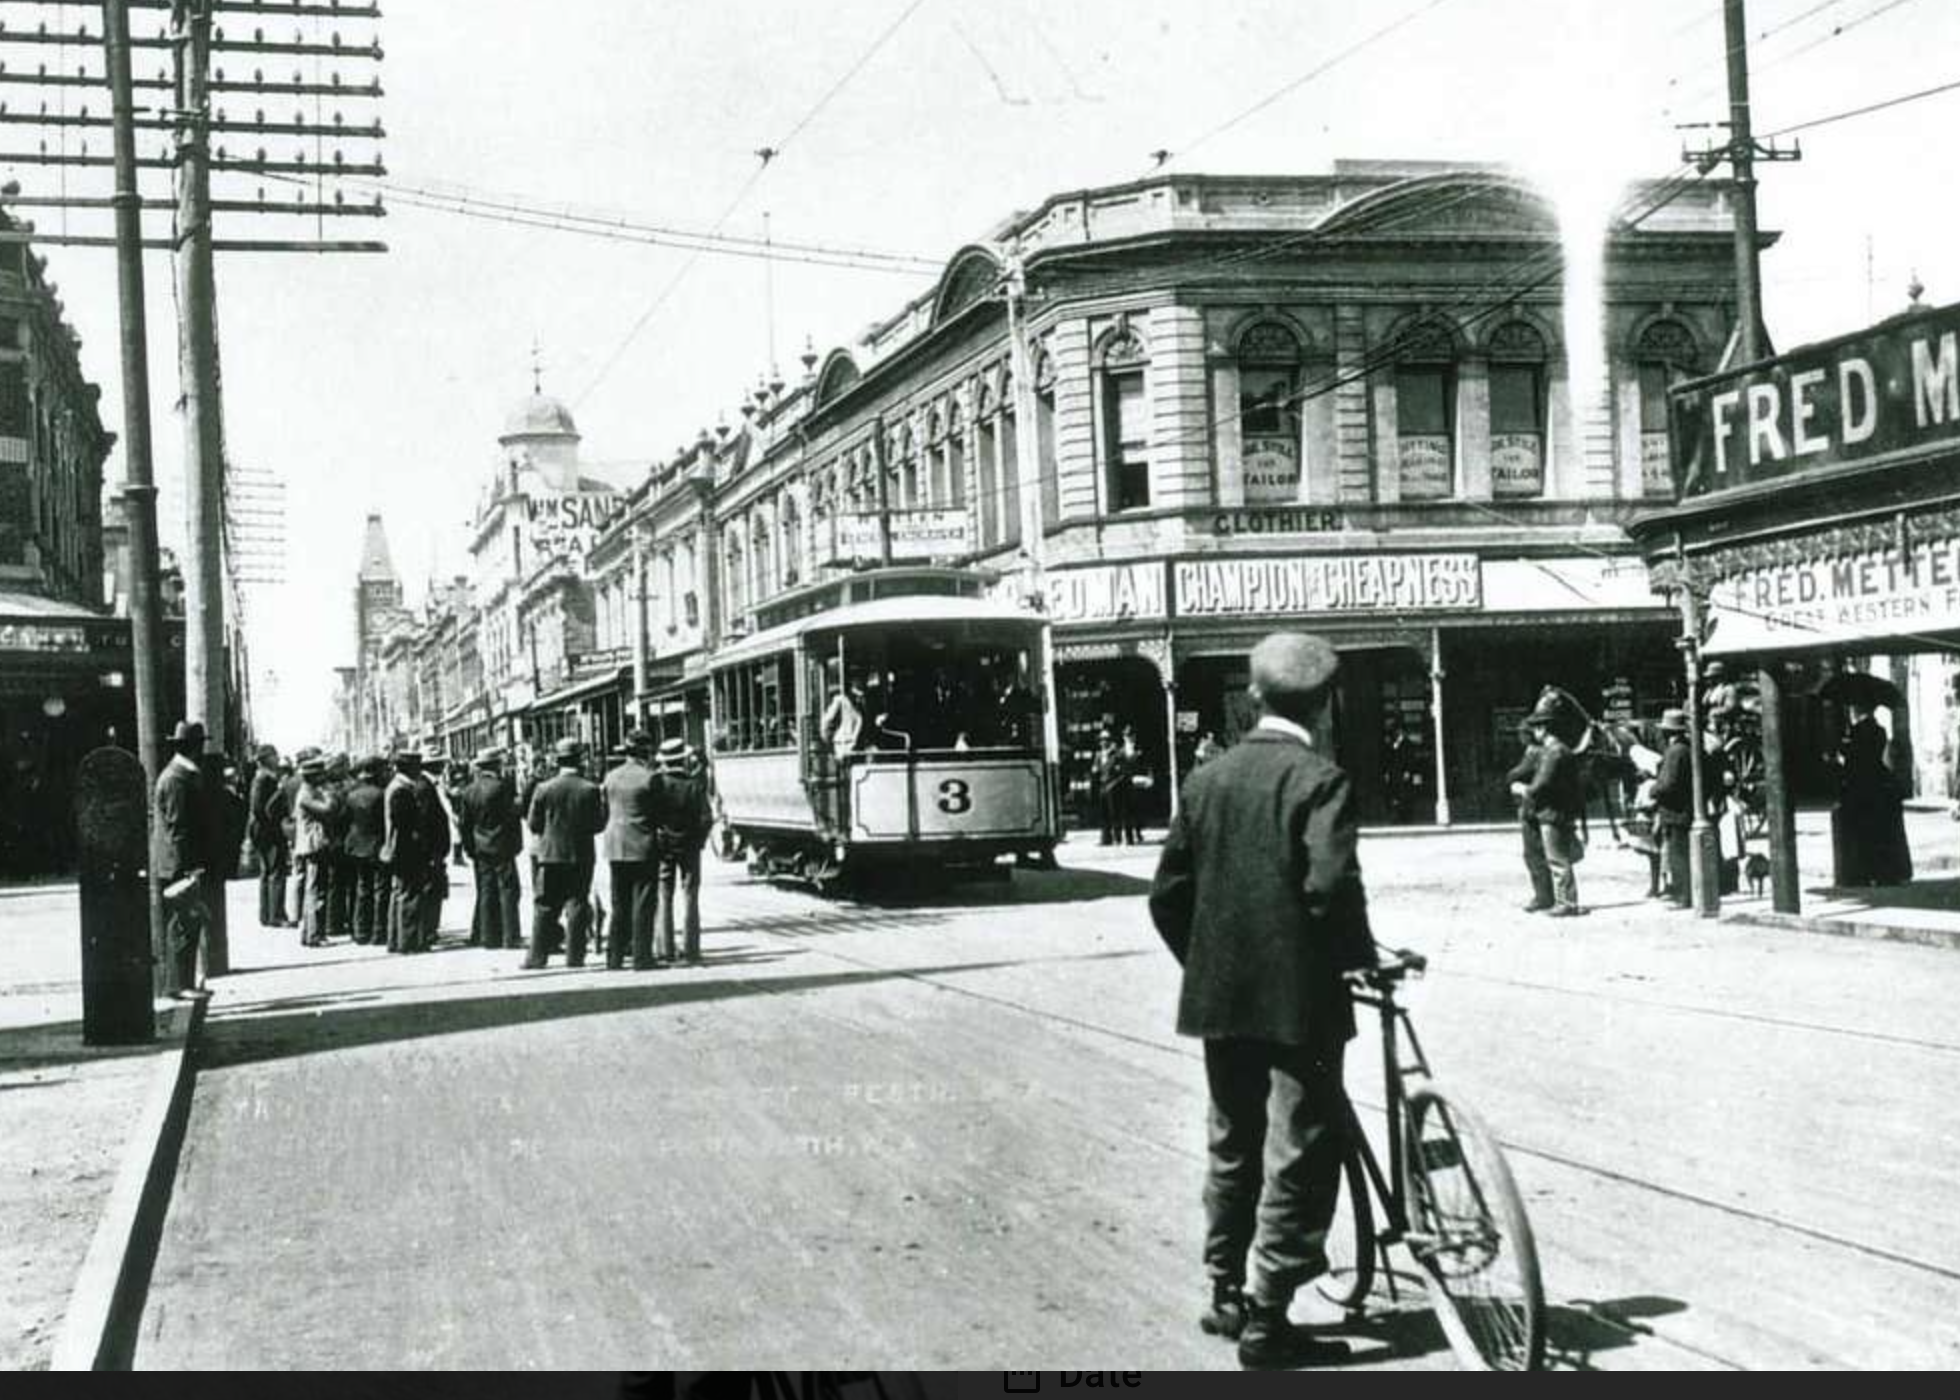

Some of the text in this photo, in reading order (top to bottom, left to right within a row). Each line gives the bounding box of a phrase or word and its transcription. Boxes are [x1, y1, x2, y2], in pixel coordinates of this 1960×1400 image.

[1712, 358, 1877, 473] FRED
[1181, 560, 1308, 614] CHAMPION
[1323, 557, 1478, 609] CHEAPNESS
[1831, 550, 1960, 599] METTE
[938, 778, 972, 815] 3
